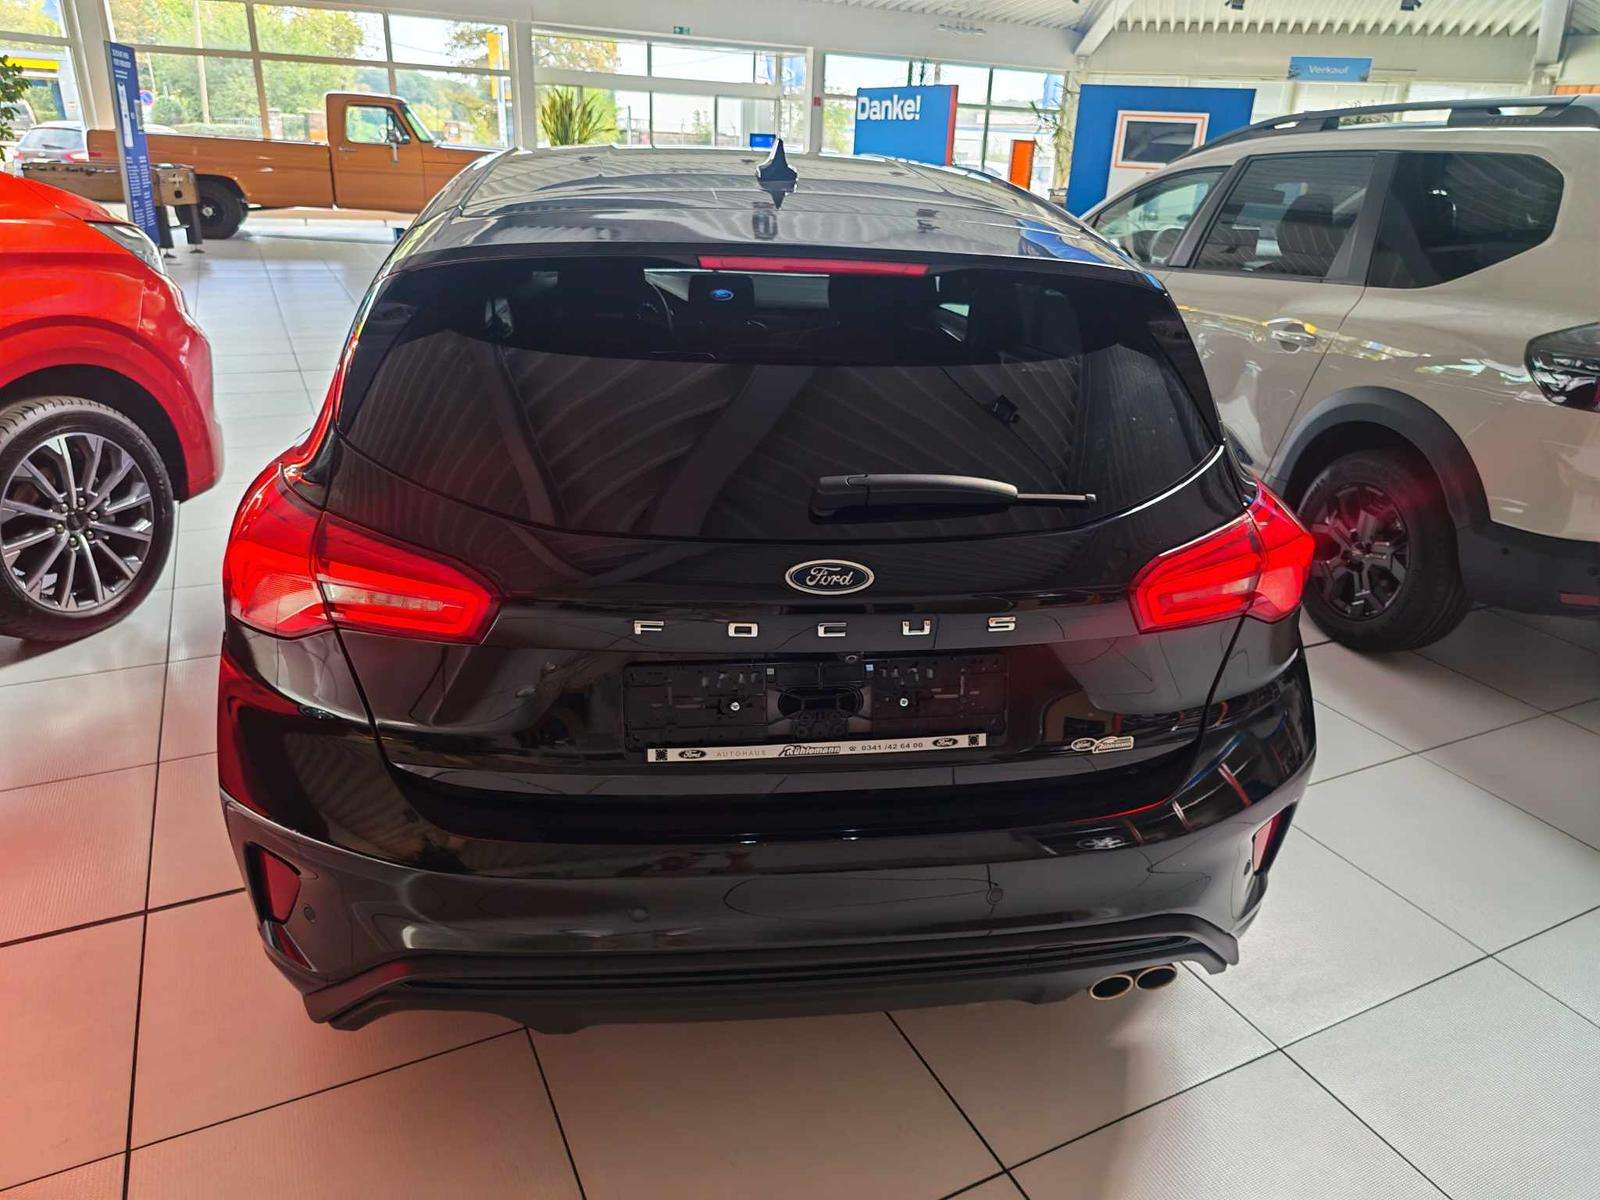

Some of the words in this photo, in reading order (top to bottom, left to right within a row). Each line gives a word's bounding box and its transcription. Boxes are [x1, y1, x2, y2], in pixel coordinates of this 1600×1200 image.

[1308, 65, 1350, 75] Verkauf
[857, 94, 922, 120] Danke!
[633, 616, 1016, 637] FOCUS
[716, 749, 767, 757] AUTOHAUS
[861, 743, 882, 751] 0341
